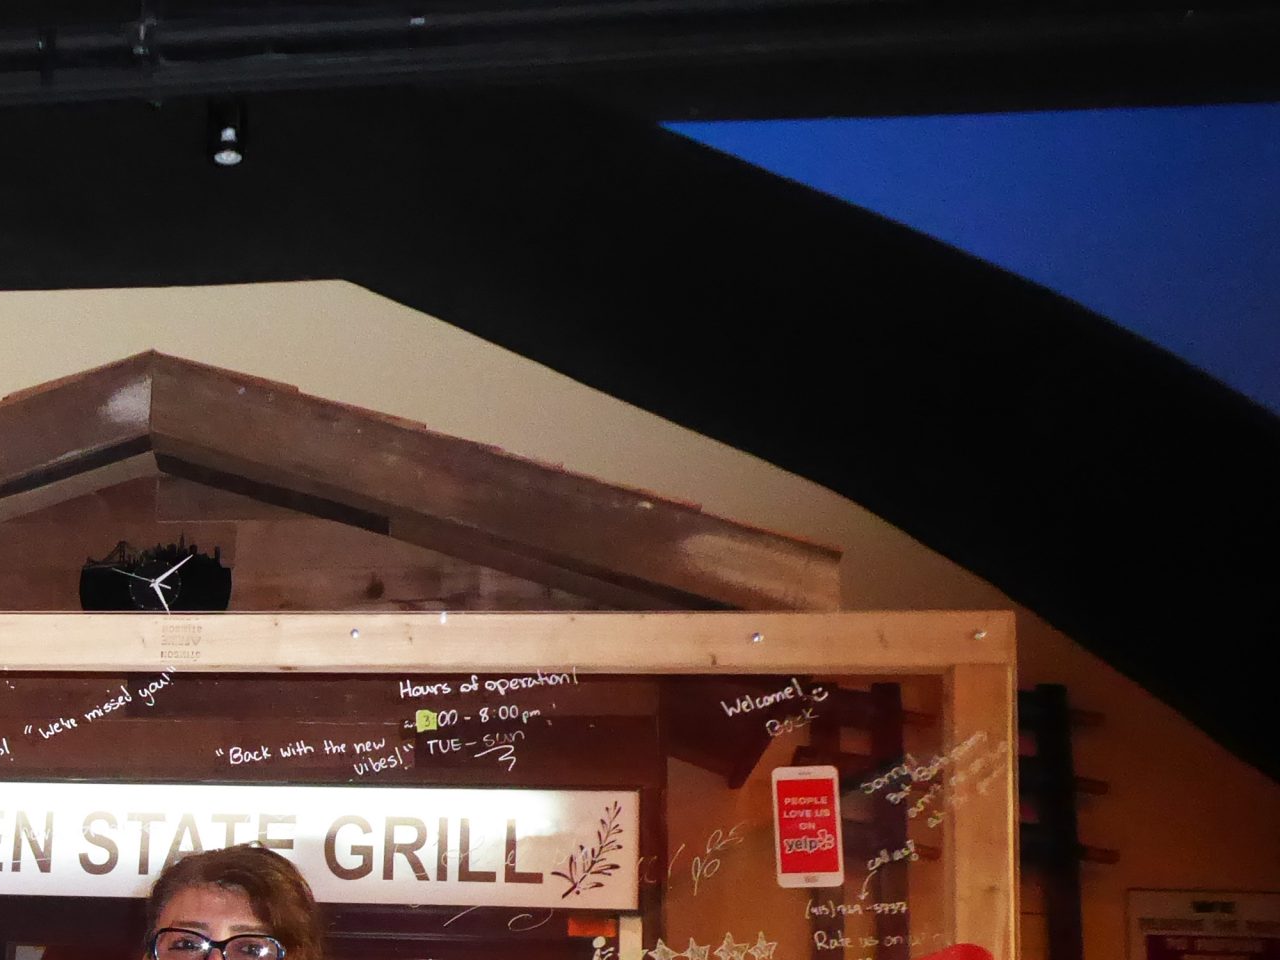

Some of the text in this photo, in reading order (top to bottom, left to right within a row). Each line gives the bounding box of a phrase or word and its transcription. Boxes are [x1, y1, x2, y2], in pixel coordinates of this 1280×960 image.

[400, 667, 579, 698] Hours of operation!
[84, 685, 132, 723] missed
[721, 677, 807, 717] Welcome!
[479, 706, 519, 723] 8:00
[522, 709, 540, 723] pm
[280, 740, 315, 758] with
[324, 740, 346, 754] the
[354, 738, 386, 752] new
[427, 738, 462, 754] TUE
[784, 796, 828, 806] PEOPLE
[783, 810, 812, 819] LOVE
[799, 822, 816, 831] ON
[324, 814, 544, 884] GRILL
[785, 837, 818, 853] yelp
[814, 930, 854, 951] Rate
